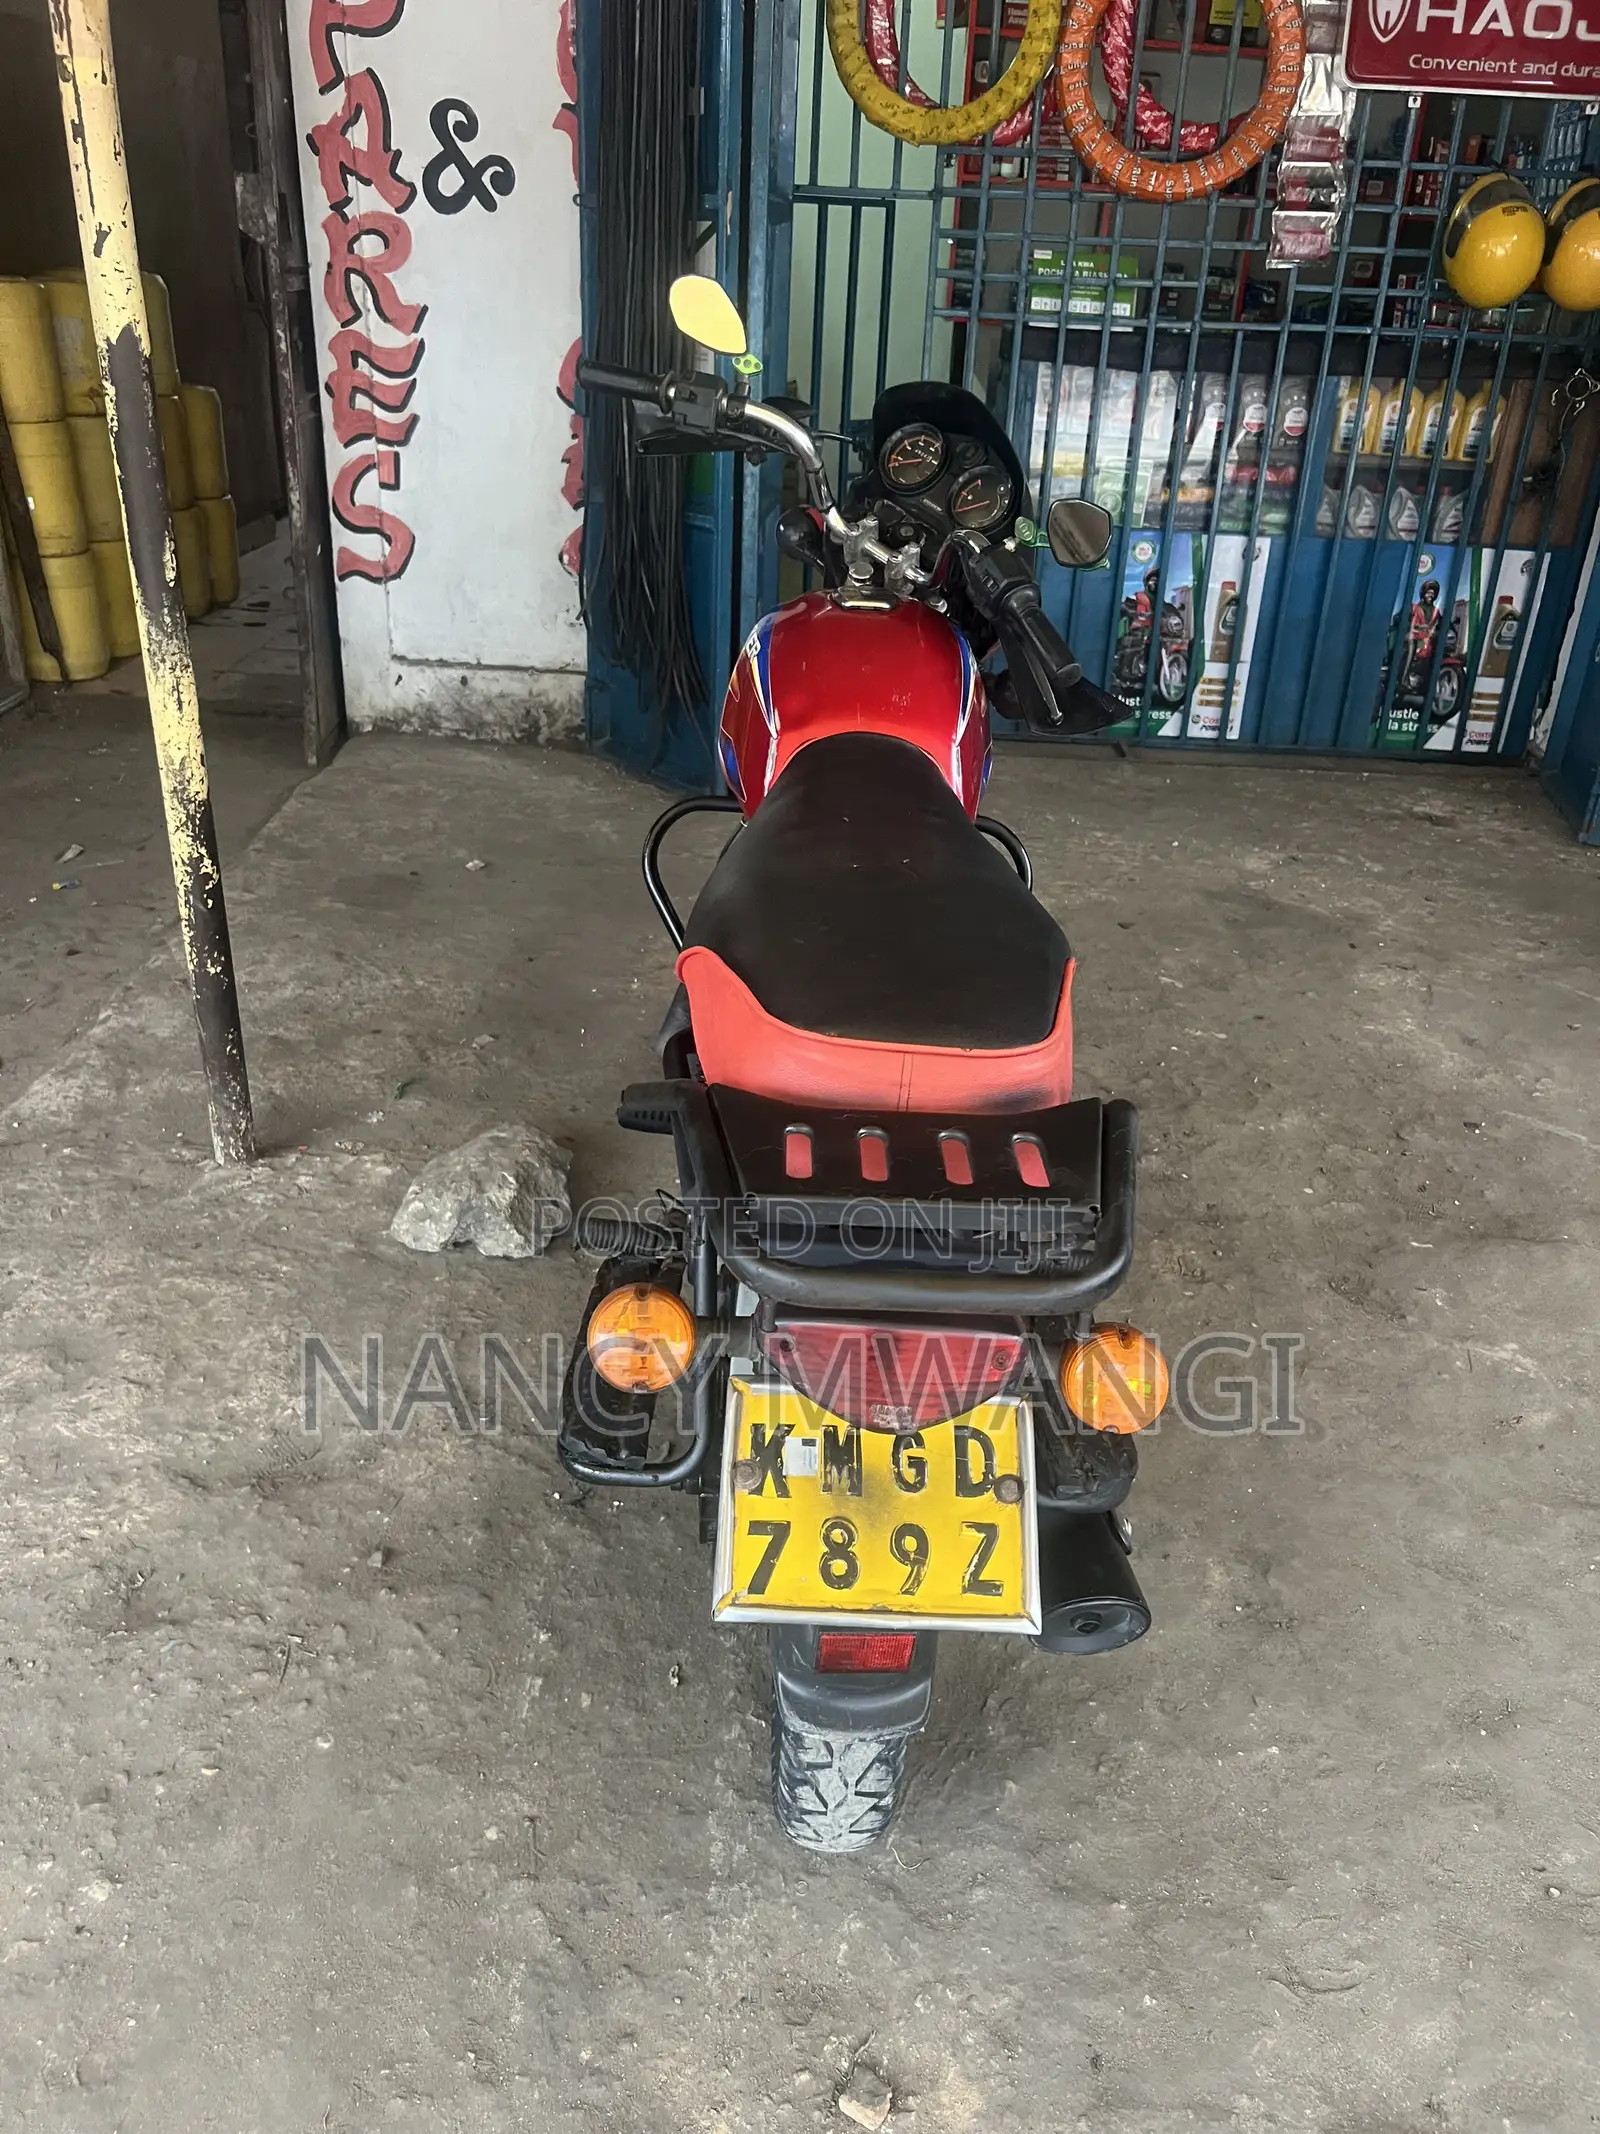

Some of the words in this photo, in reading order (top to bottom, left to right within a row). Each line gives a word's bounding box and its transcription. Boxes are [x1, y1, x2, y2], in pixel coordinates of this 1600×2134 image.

[1409, 54, 1517, 74] Convenient
[1521, 60, 1559, 76] and
[422, 97, 516, 216] &
[1037, 267, 1066, 277] POCH
[1134, 709, 1173, 720] sress
[1380, 707, 1420, 720] ustle
[1401, 720, 1440, 734] strss
[746, 1516, 1005, 1598] 789Z
